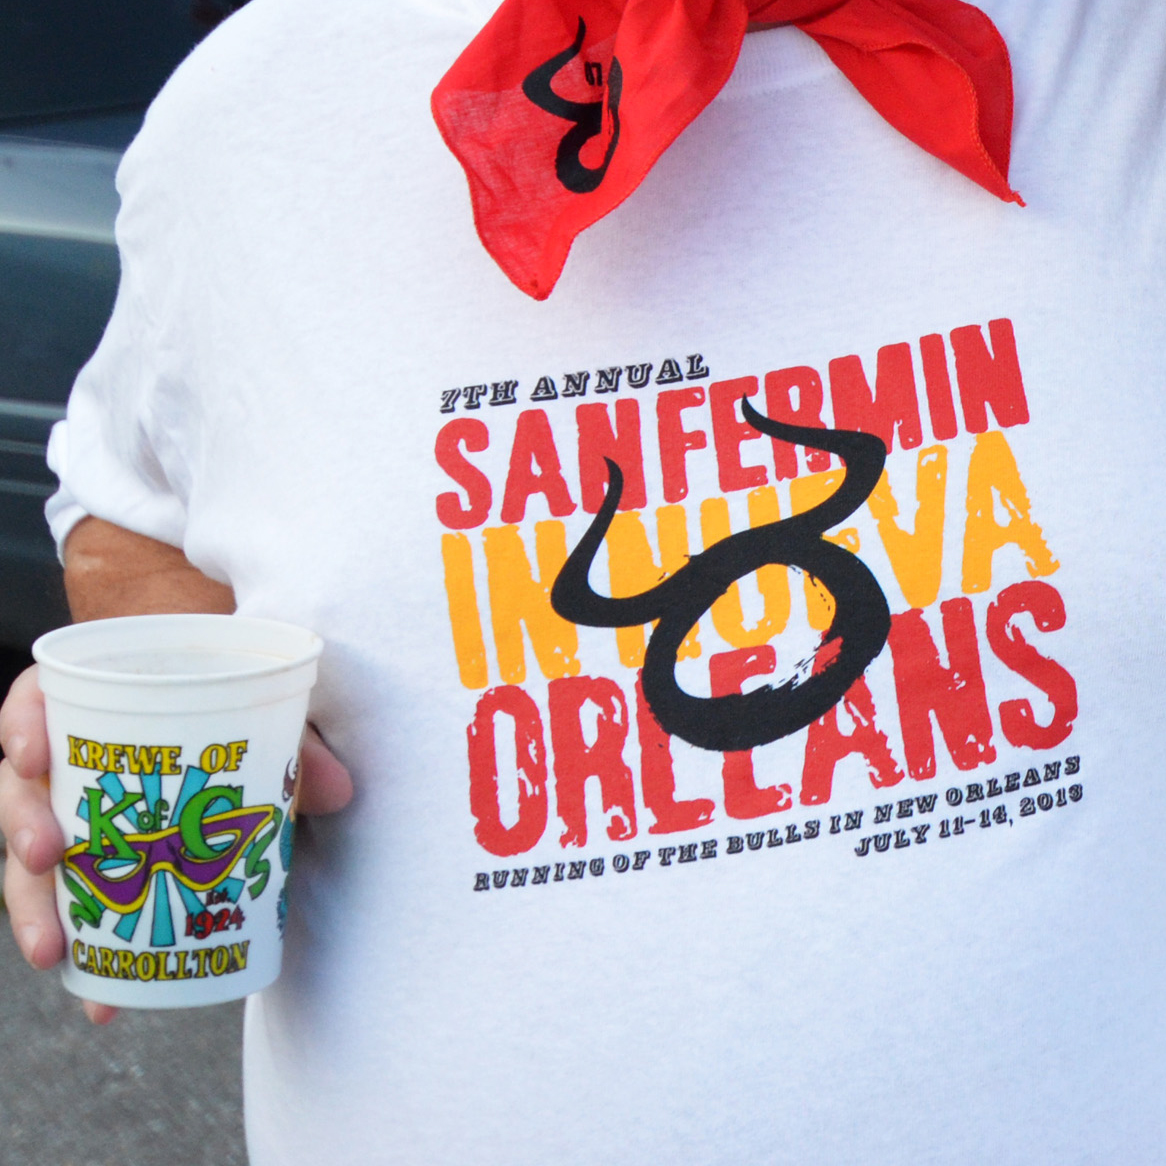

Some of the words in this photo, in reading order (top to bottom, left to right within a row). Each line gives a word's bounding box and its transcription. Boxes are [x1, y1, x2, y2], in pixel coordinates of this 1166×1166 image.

[440, 380, 518, 413] 7TH
[530, 354, 709, 401] ANNUAL
[466, 580, 1078, 857] ORLEANS
[67, 735, 182, 776] KREWE
[200, 739, 249, 774] OF
[473, 857, 605, 891] RUNNING
[612, 850, 651, 872] OF
[658, 838, 717, 867] THE
[726, 818, 820, 854] BULLS
[829, 810, 863, 835] IN
[873, 793, 938, 824] NEW
[946, 755, 1081, 807] ORLEANS
[854, 823, 930, 857] JULY
[1019, 783, 1083, 817] 2013
[184, 904, 246, 940] 1924
[72, 938, 250, 982] CARROLLTON
